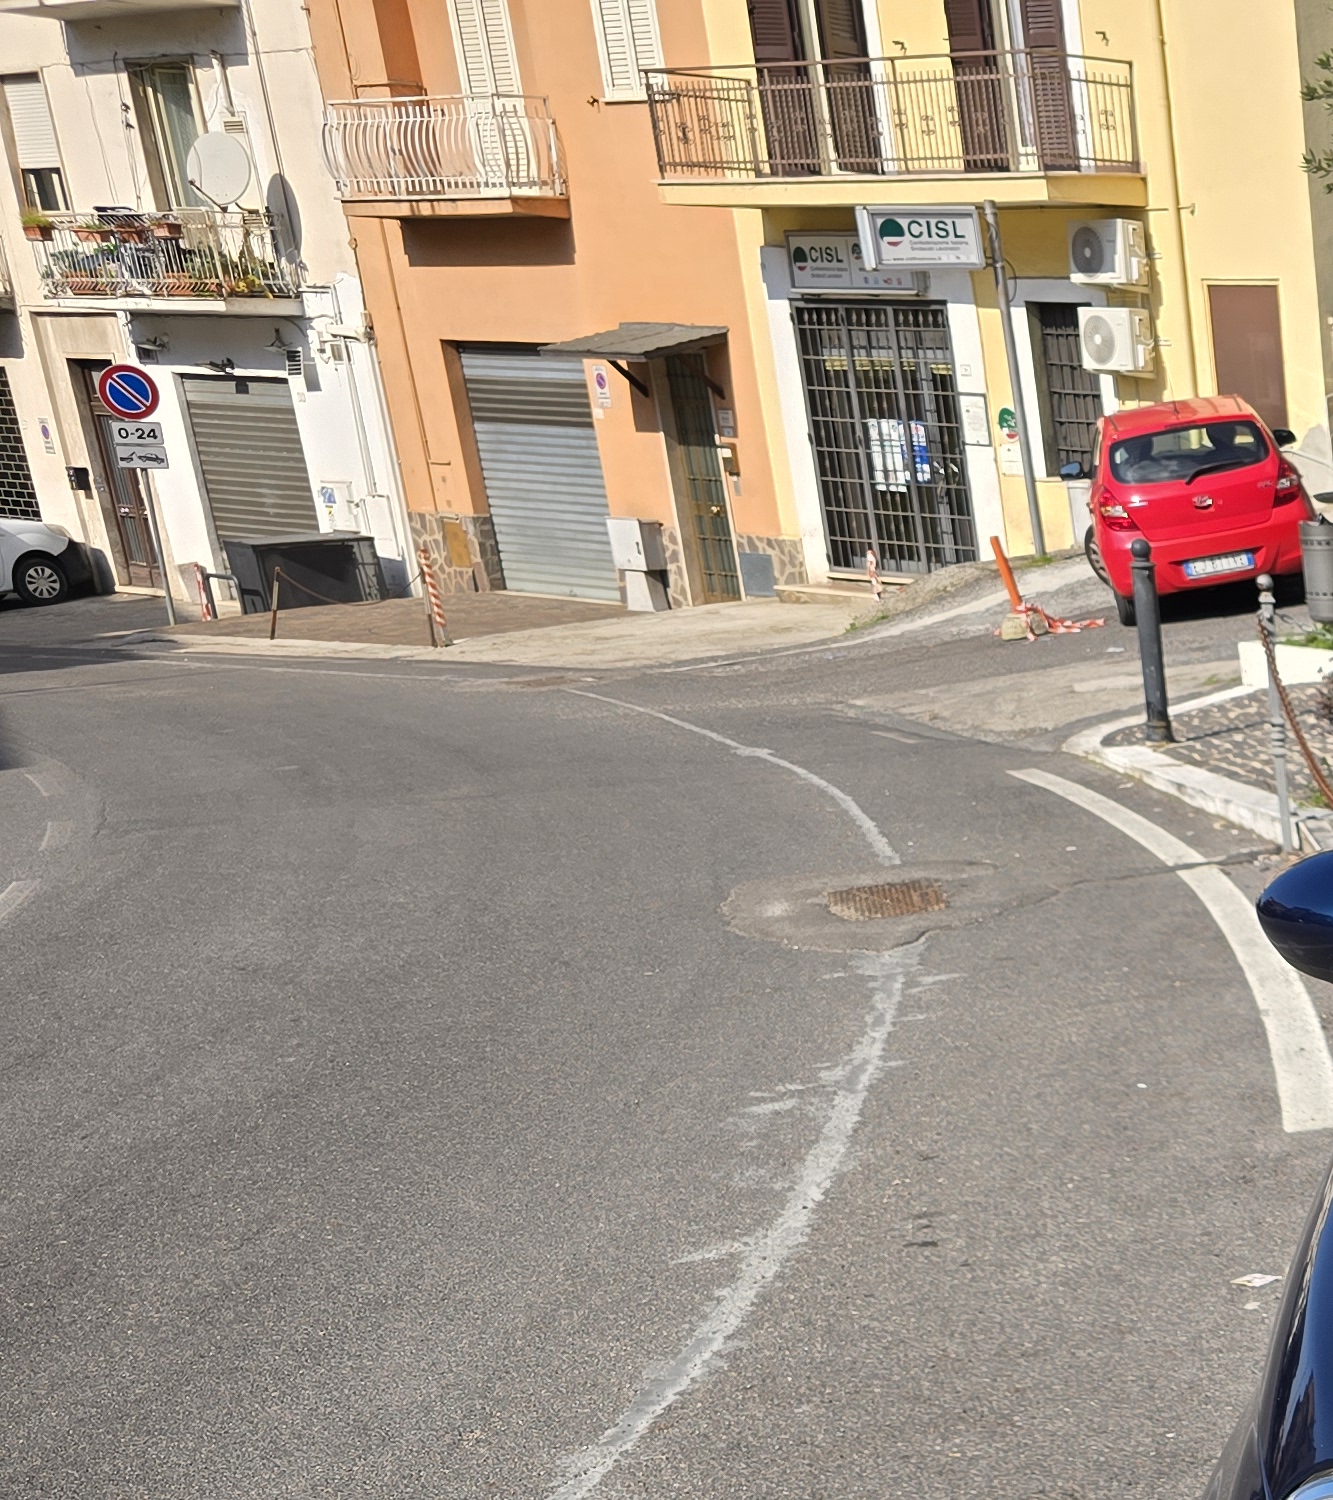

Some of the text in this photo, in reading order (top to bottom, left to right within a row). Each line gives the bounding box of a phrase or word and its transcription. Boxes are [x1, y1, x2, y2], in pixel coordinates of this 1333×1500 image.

[908, 220, 966, 239] CISL
[809, 246, 844, 263] CISL
[118, 427, 158, 439] 0-24
